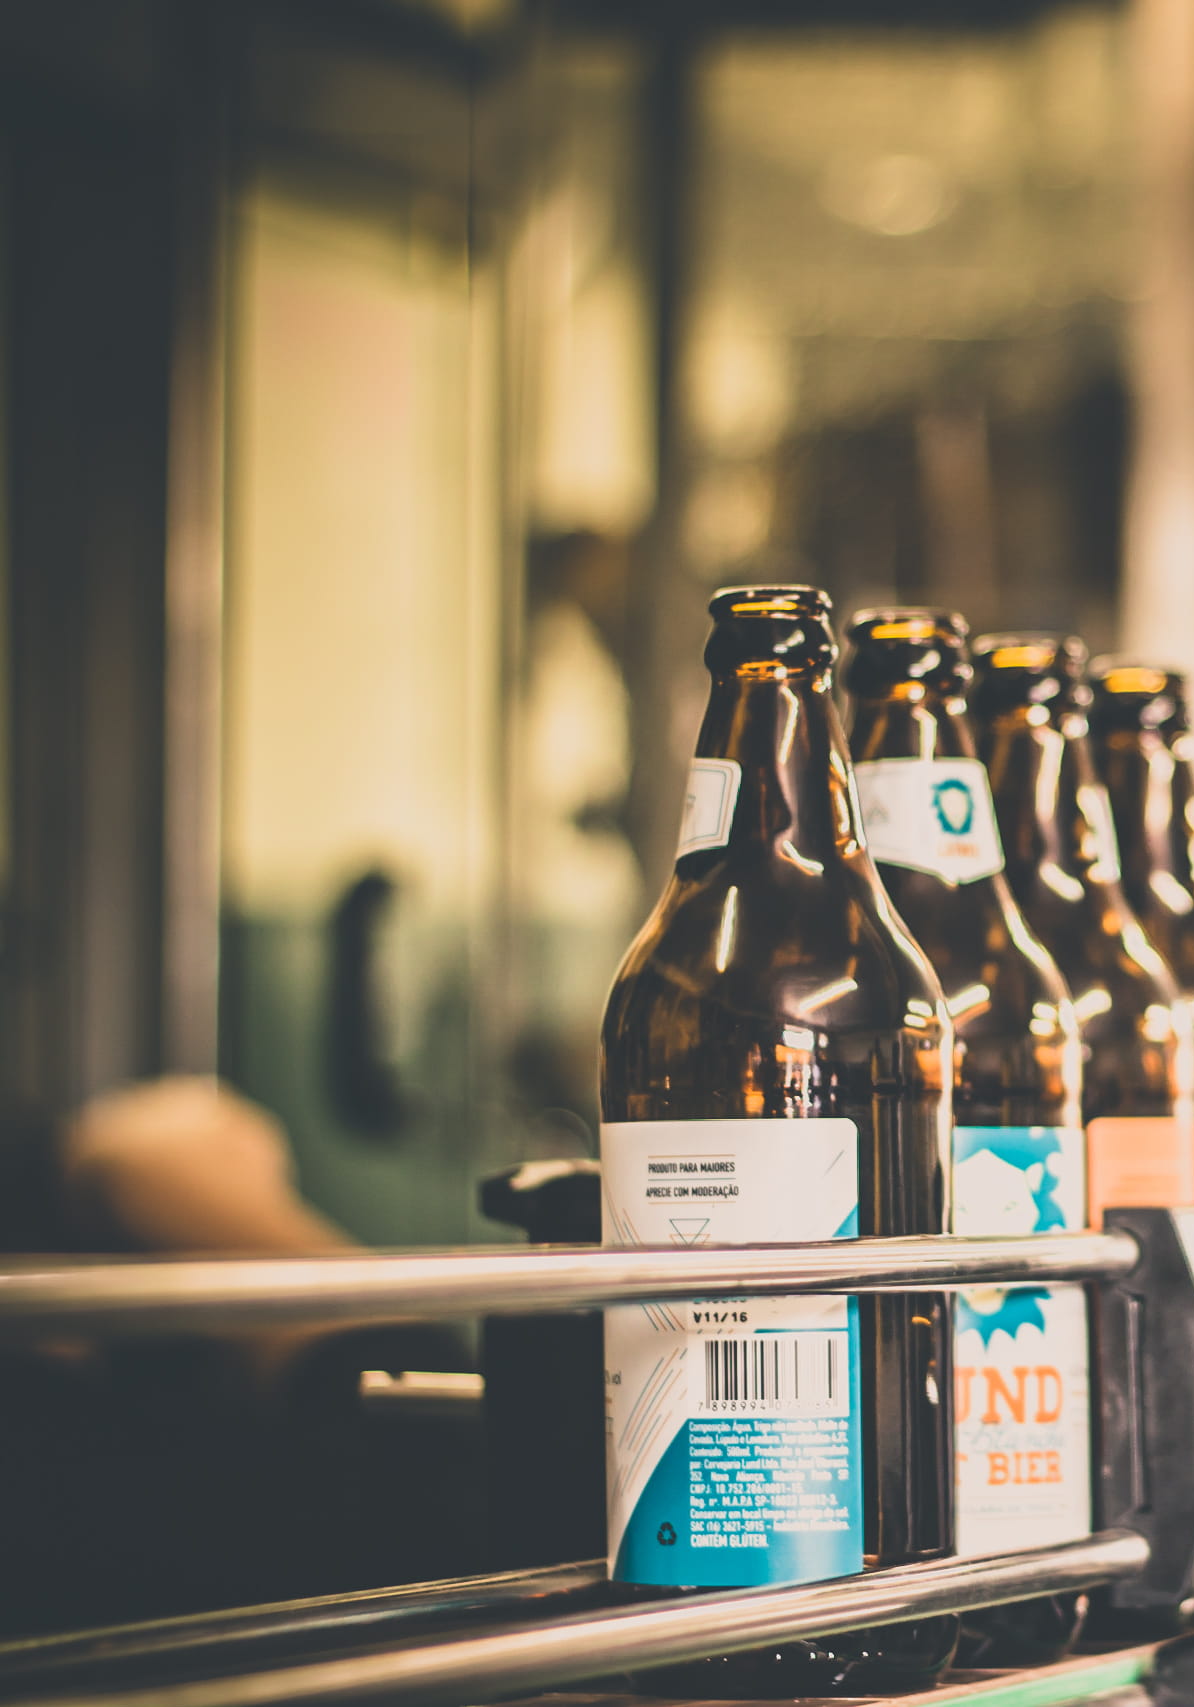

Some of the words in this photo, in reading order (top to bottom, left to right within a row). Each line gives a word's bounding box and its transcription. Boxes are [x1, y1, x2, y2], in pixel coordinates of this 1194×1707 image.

[648, 1163, 677, 1174] PRODUTO
[680, 1162, 698, 1172] PARA
[700, 1162, 735, 1172] MAIORES
[646, 1187, 671, 1197] APRECIE
[674, 1187, 688, 1196] COM
[692, 1184, 739, 1198] MODERAÇÃO
[988, 1451, 1063, 1486] BIER
